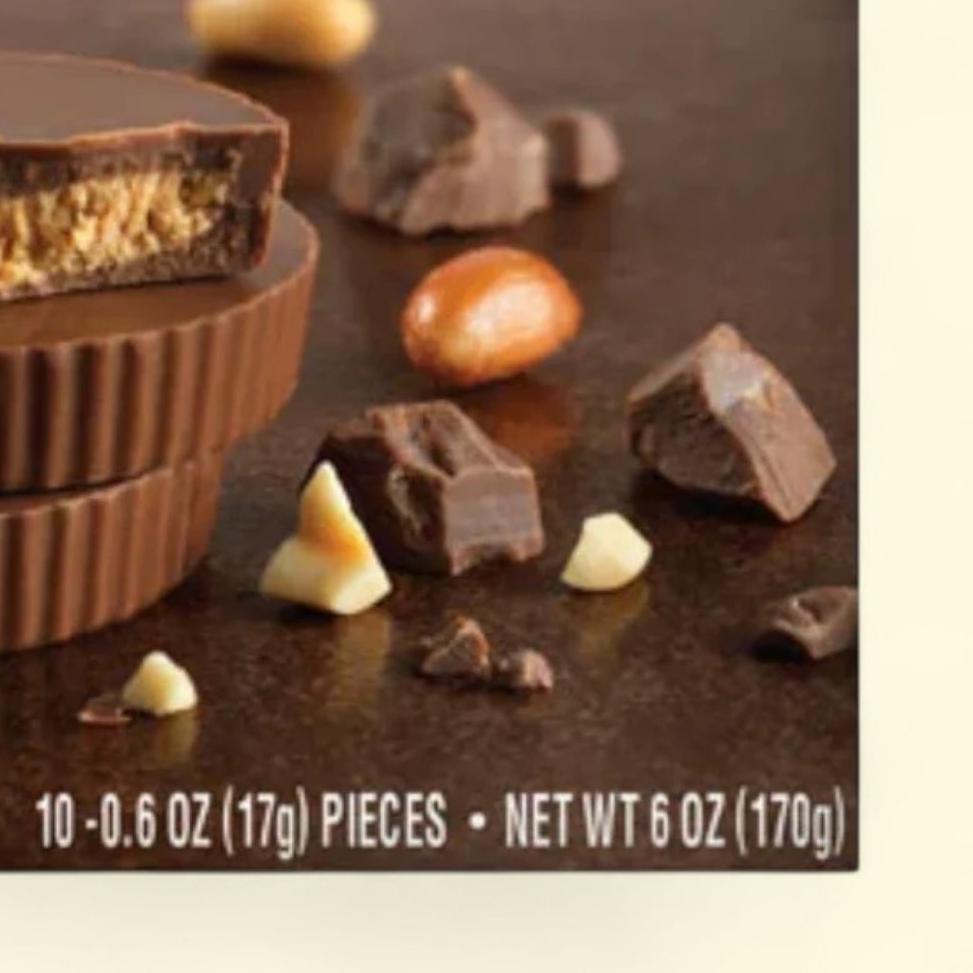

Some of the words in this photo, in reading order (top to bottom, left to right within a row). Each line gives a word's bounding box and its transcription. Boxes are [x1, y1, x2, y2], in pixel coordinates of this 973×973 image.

[36, 792, 74, 848] 10
[167, 792, 212, 848] OZ
[222, 786, 310, 860] (17g)
[321, 792, 448, 848] PIECES
[504, 792, 573, 848] NET
[581, 792, 640, 848] WT
[649, 792, 671, 848] 6
[680, 792, 726, 848] OZ
[735, 786, 846, 860] (170g)
